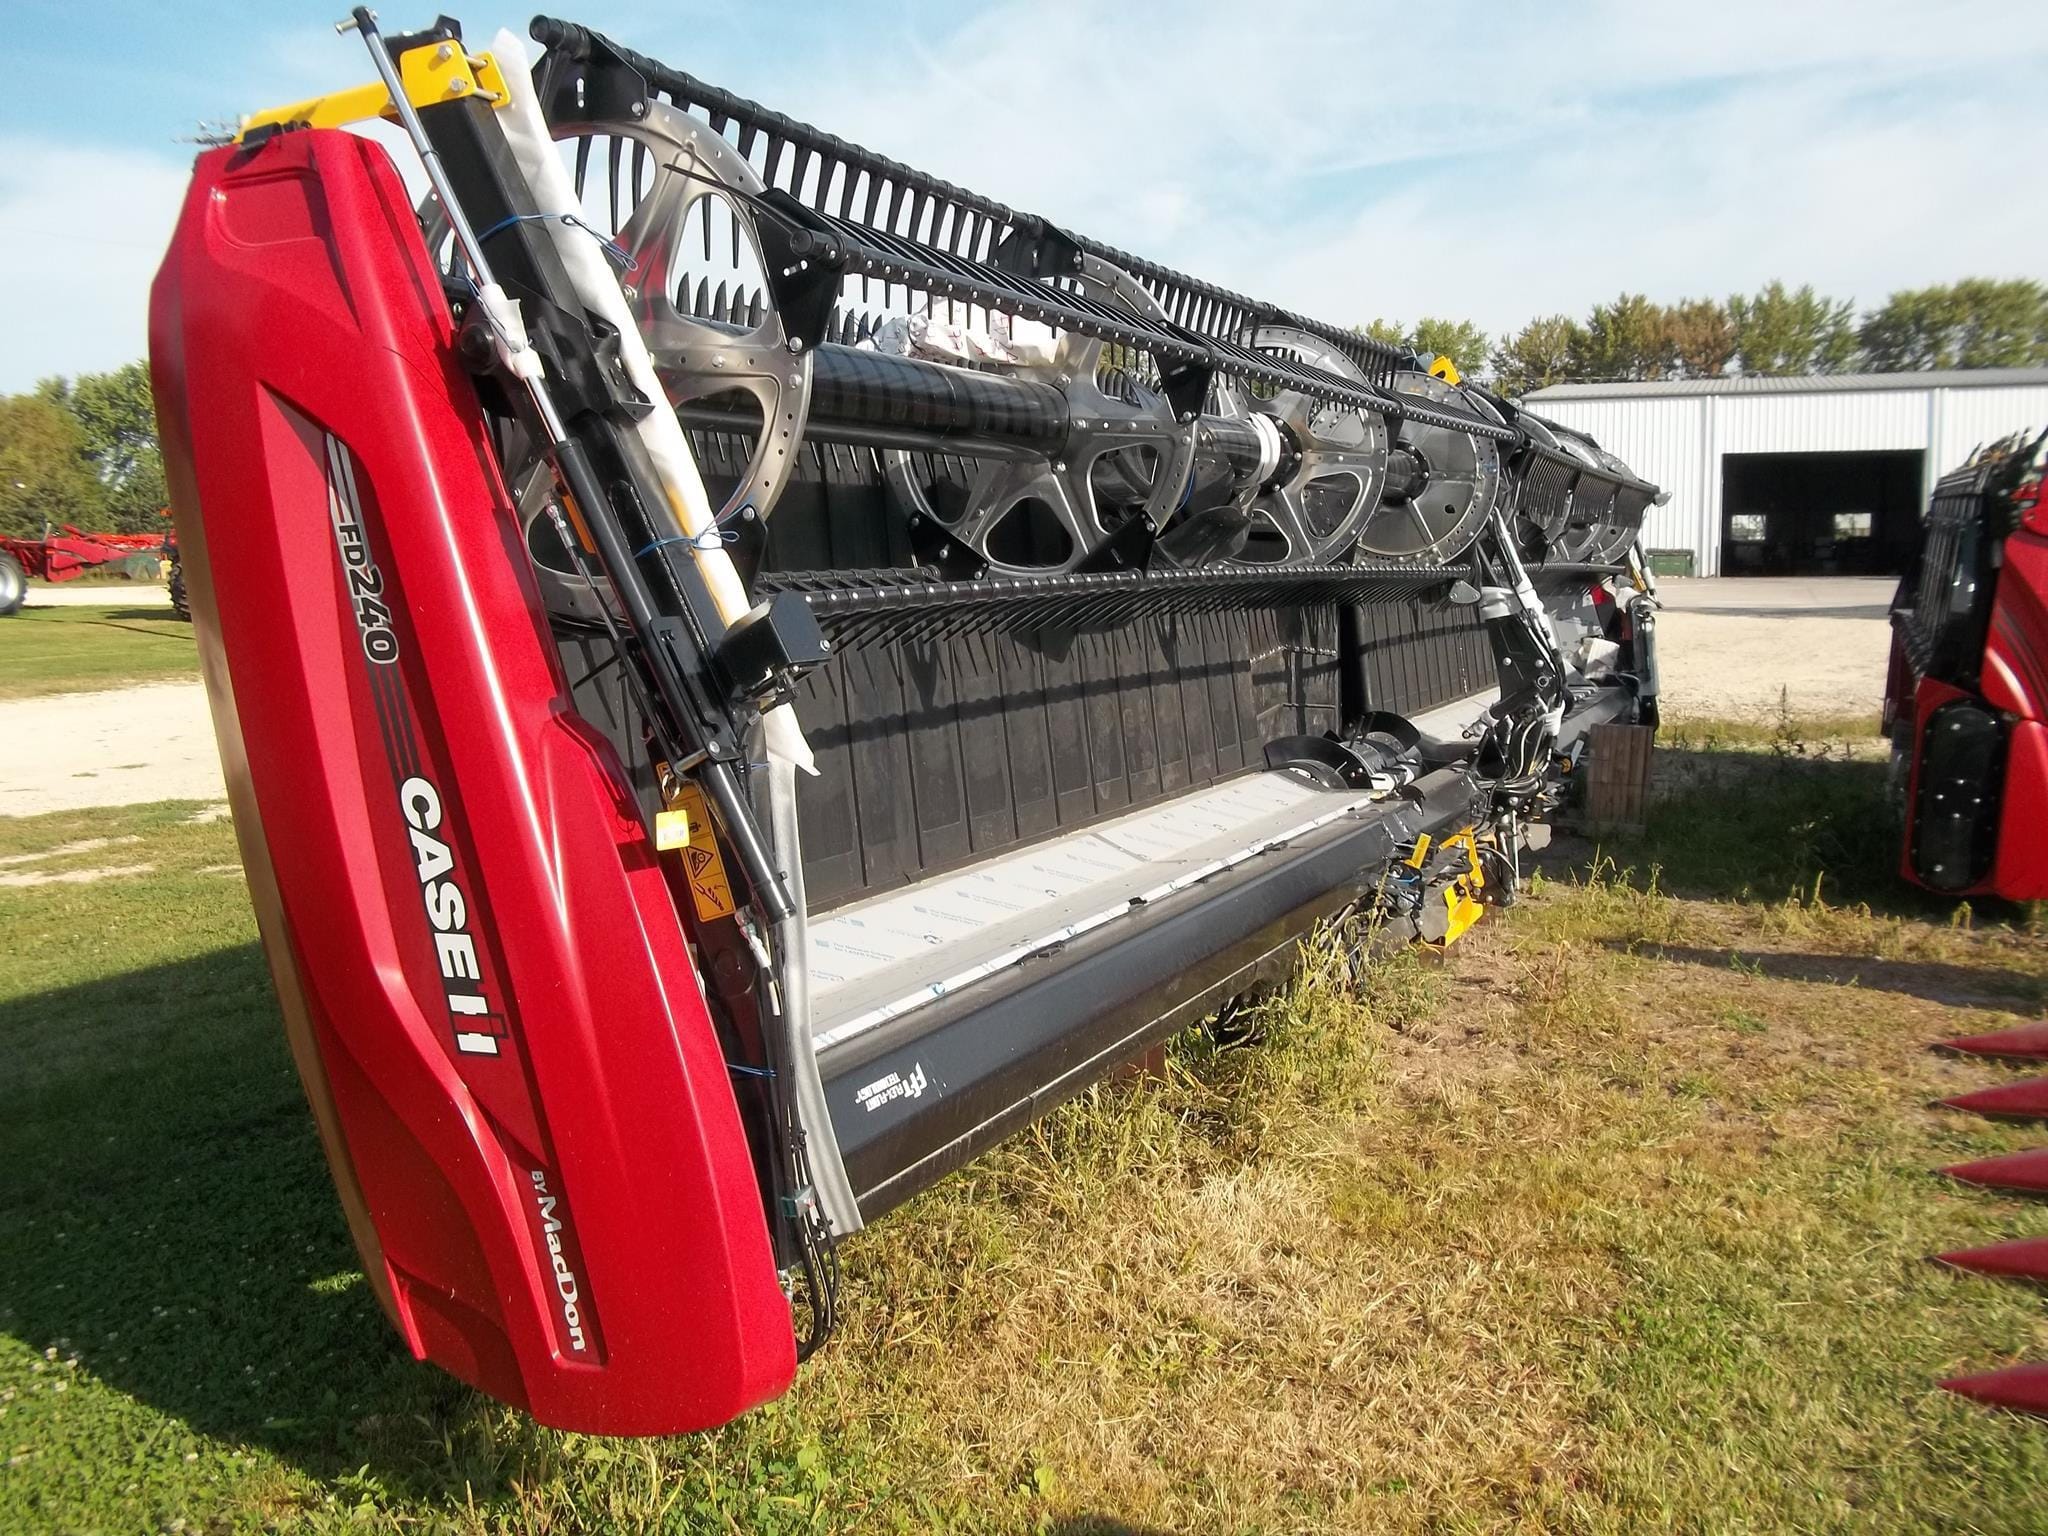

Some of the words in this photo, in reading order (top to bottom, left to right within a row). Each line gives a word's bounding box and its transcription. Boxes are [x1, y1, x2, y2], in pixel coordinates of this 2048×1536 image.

[338, 522, 399, 664] FD240
[401, 777, 481, 980] CASE
[531, 1170, 548, 1194] BY
[537, 1196, 586, 1351] MacDon
